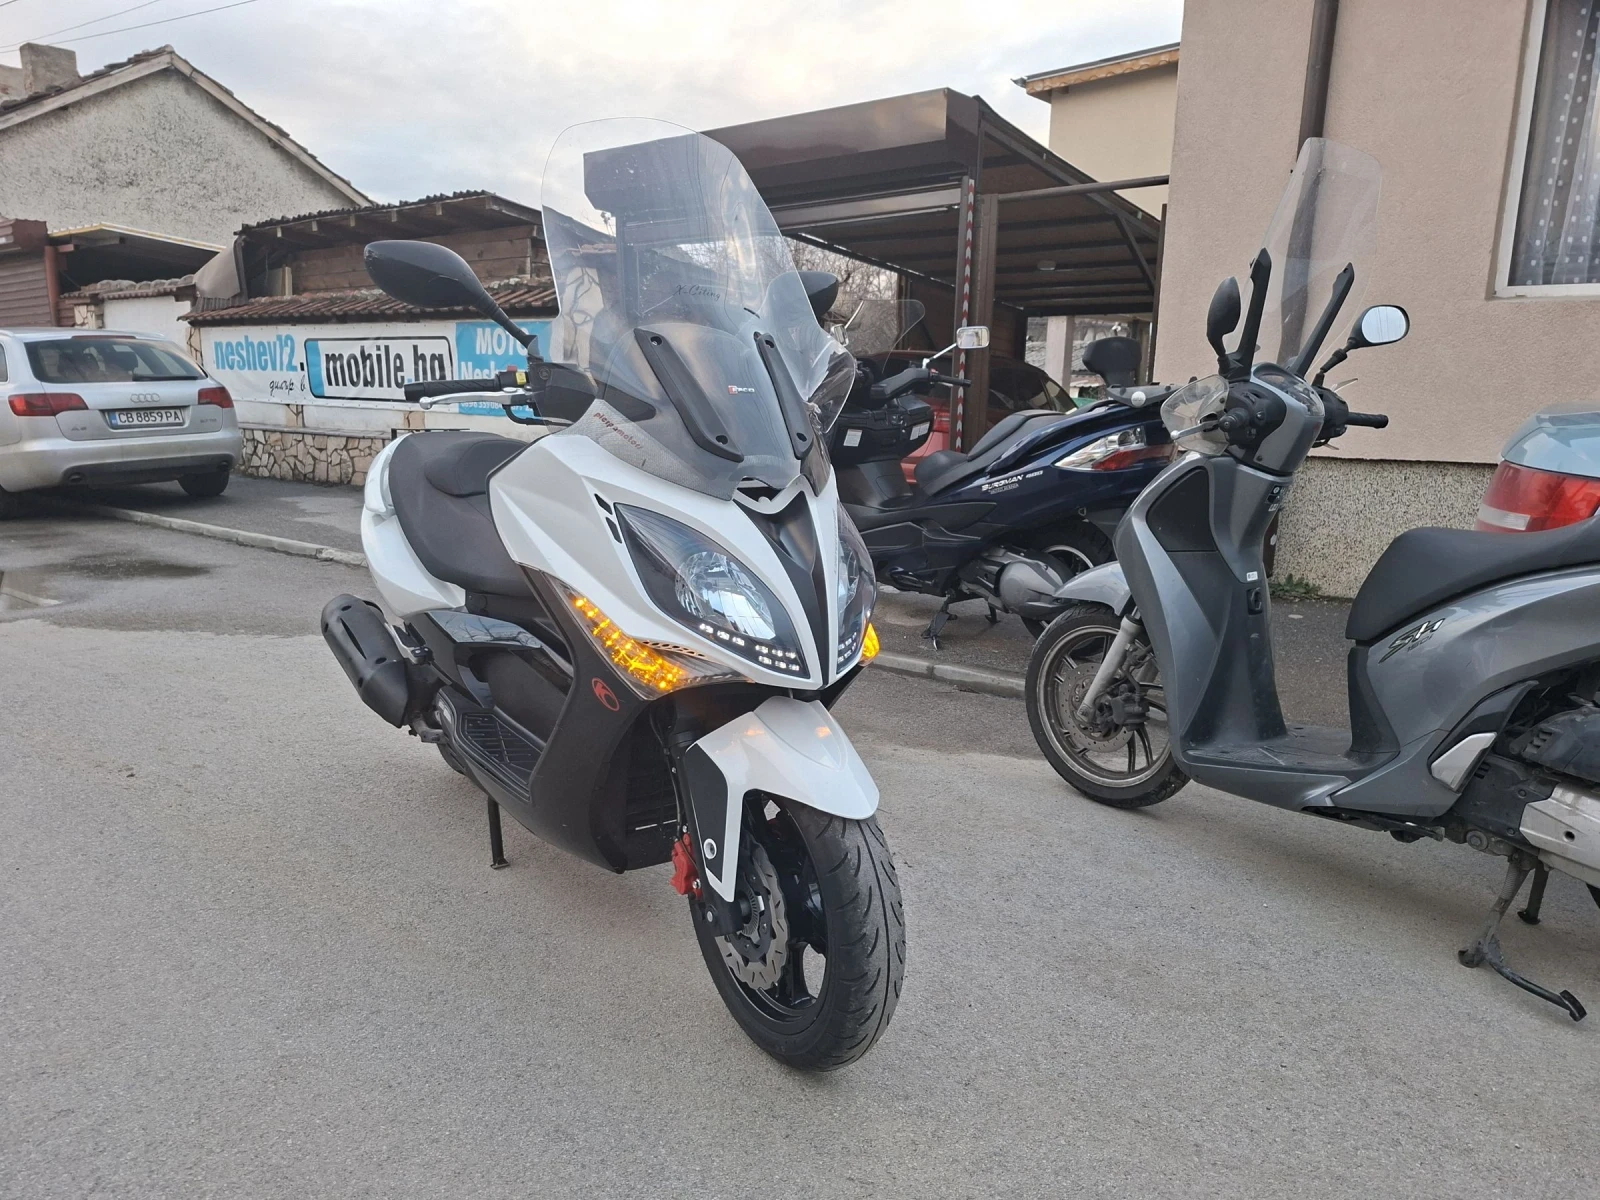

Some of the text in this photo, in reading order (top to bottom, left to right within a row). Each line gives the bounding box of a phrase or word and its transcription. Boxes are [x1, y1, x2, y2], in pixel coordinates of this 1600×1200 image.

[117, 409, 181, 424] CB 8859 PA
